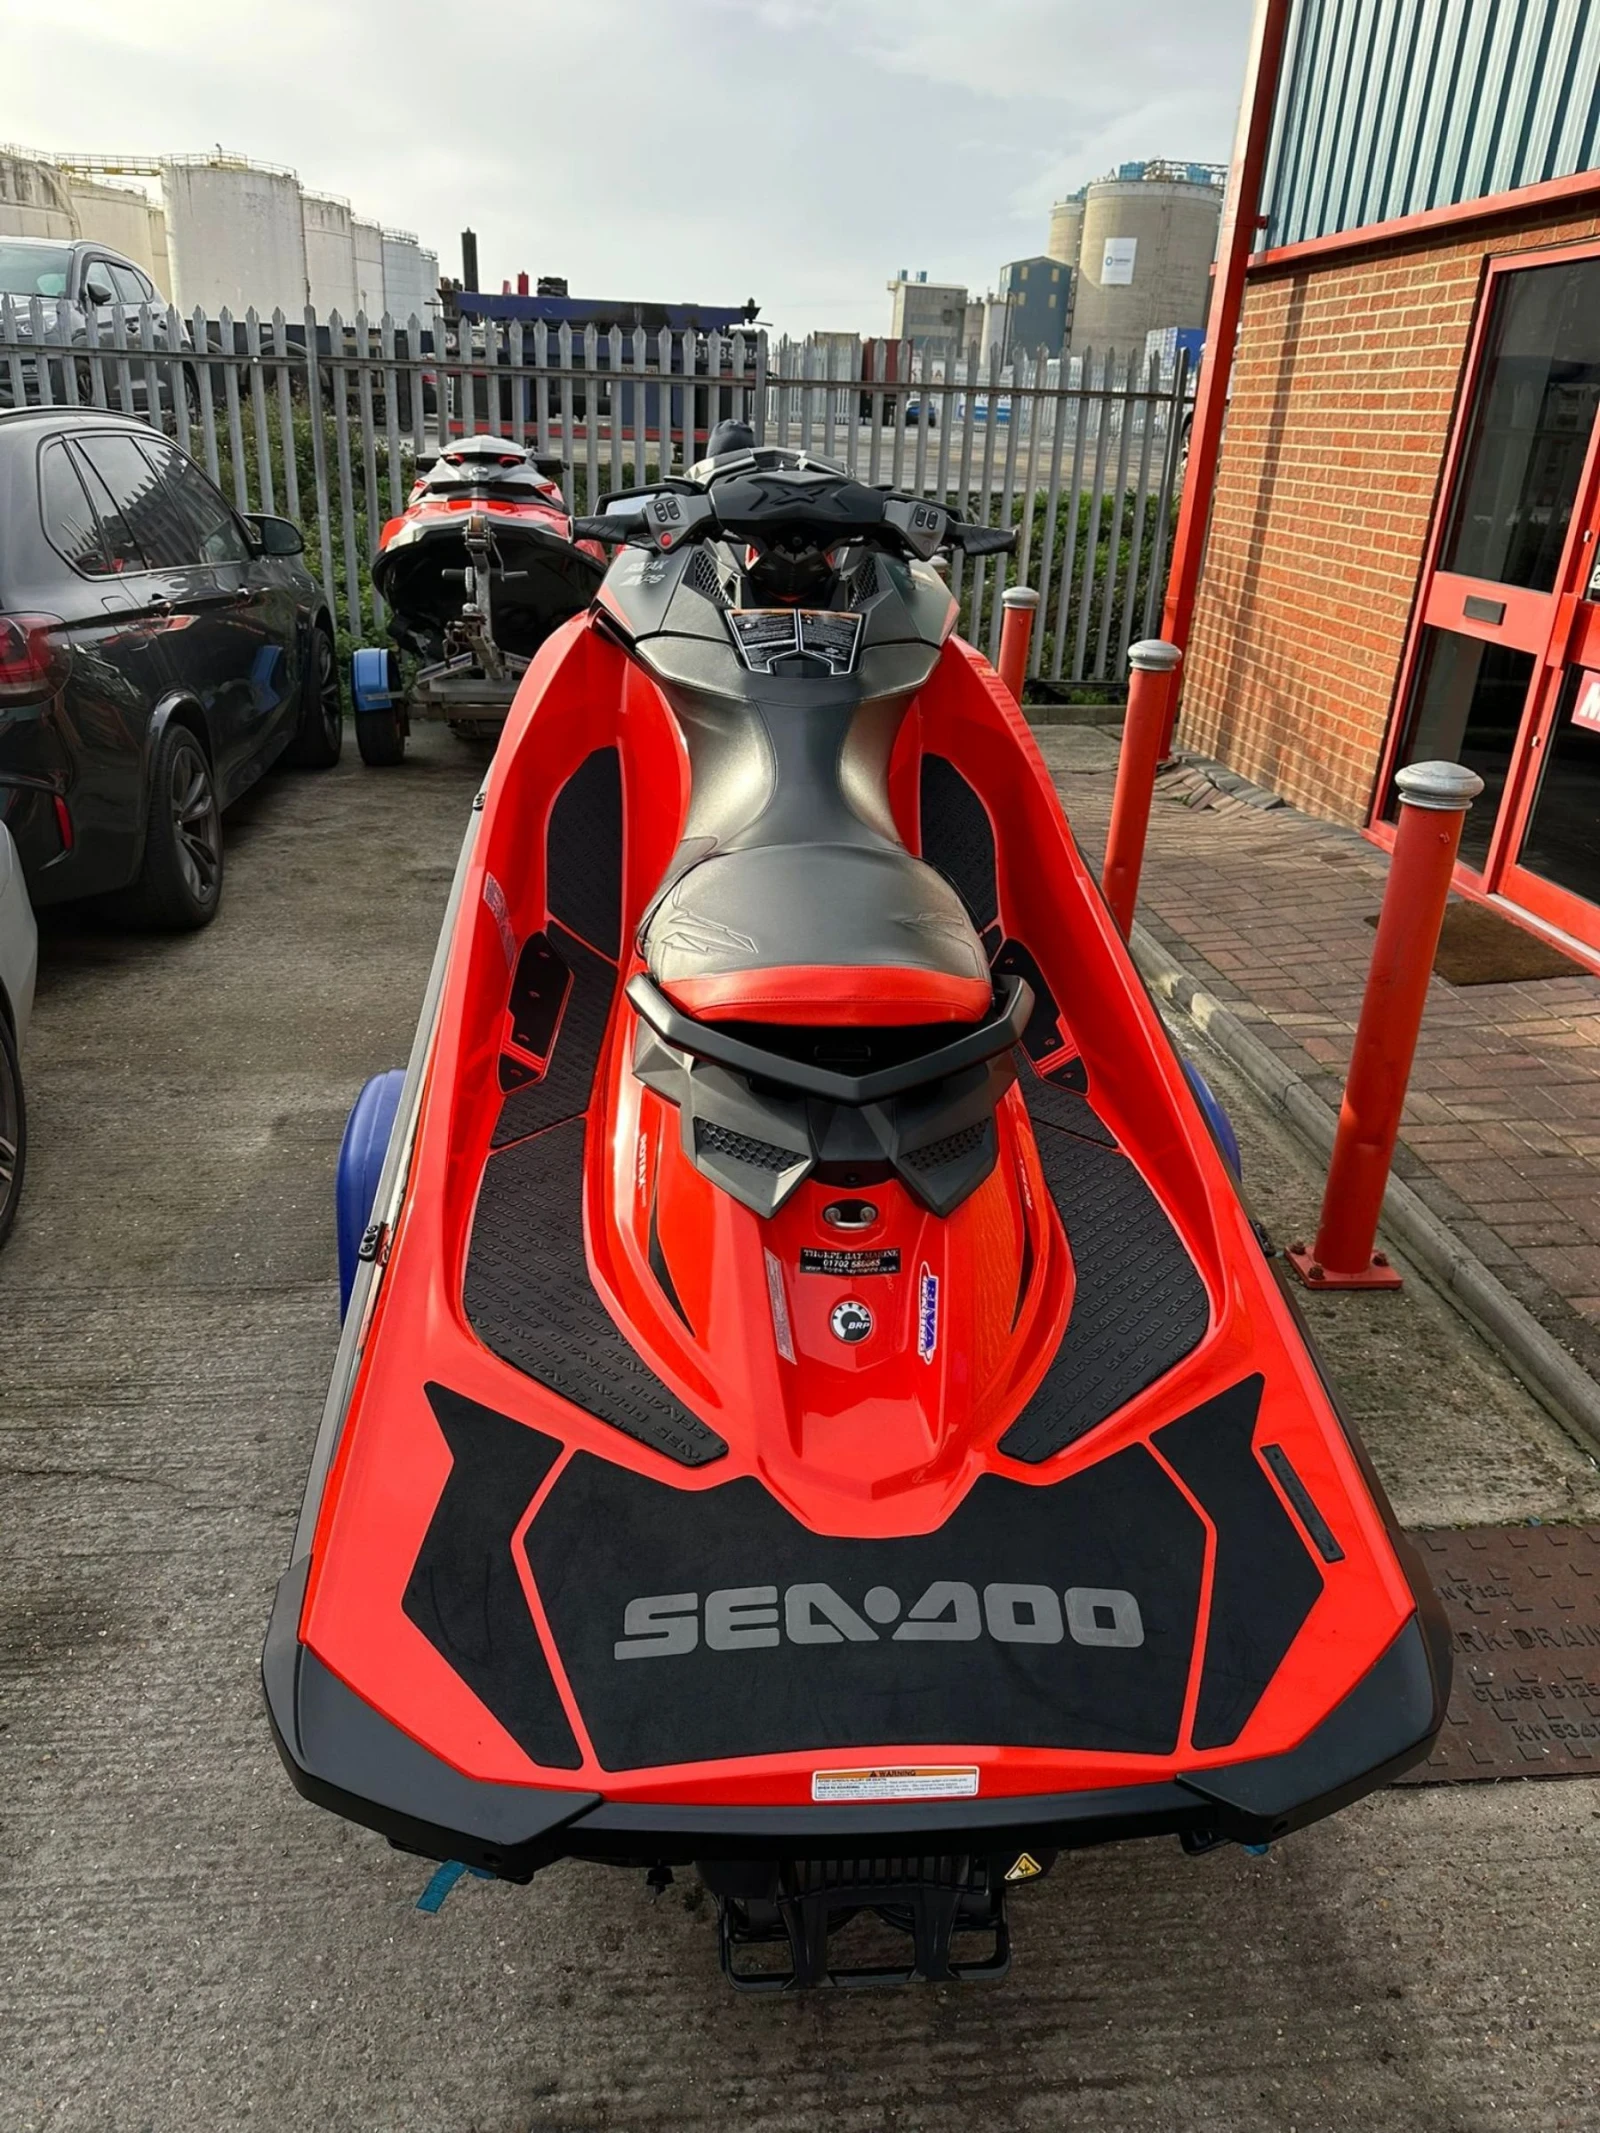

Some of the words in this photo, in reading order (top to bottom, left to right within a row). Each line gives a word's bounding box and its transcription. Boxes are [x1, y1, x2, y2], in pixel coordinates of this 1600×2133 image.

[844, 1252, 864, 1261] BAY
[823, 1259, 849, 1268] 01702
[847, 1321, 871, 1330] BRP
[879, 1769, 916, 1777] WARNING
